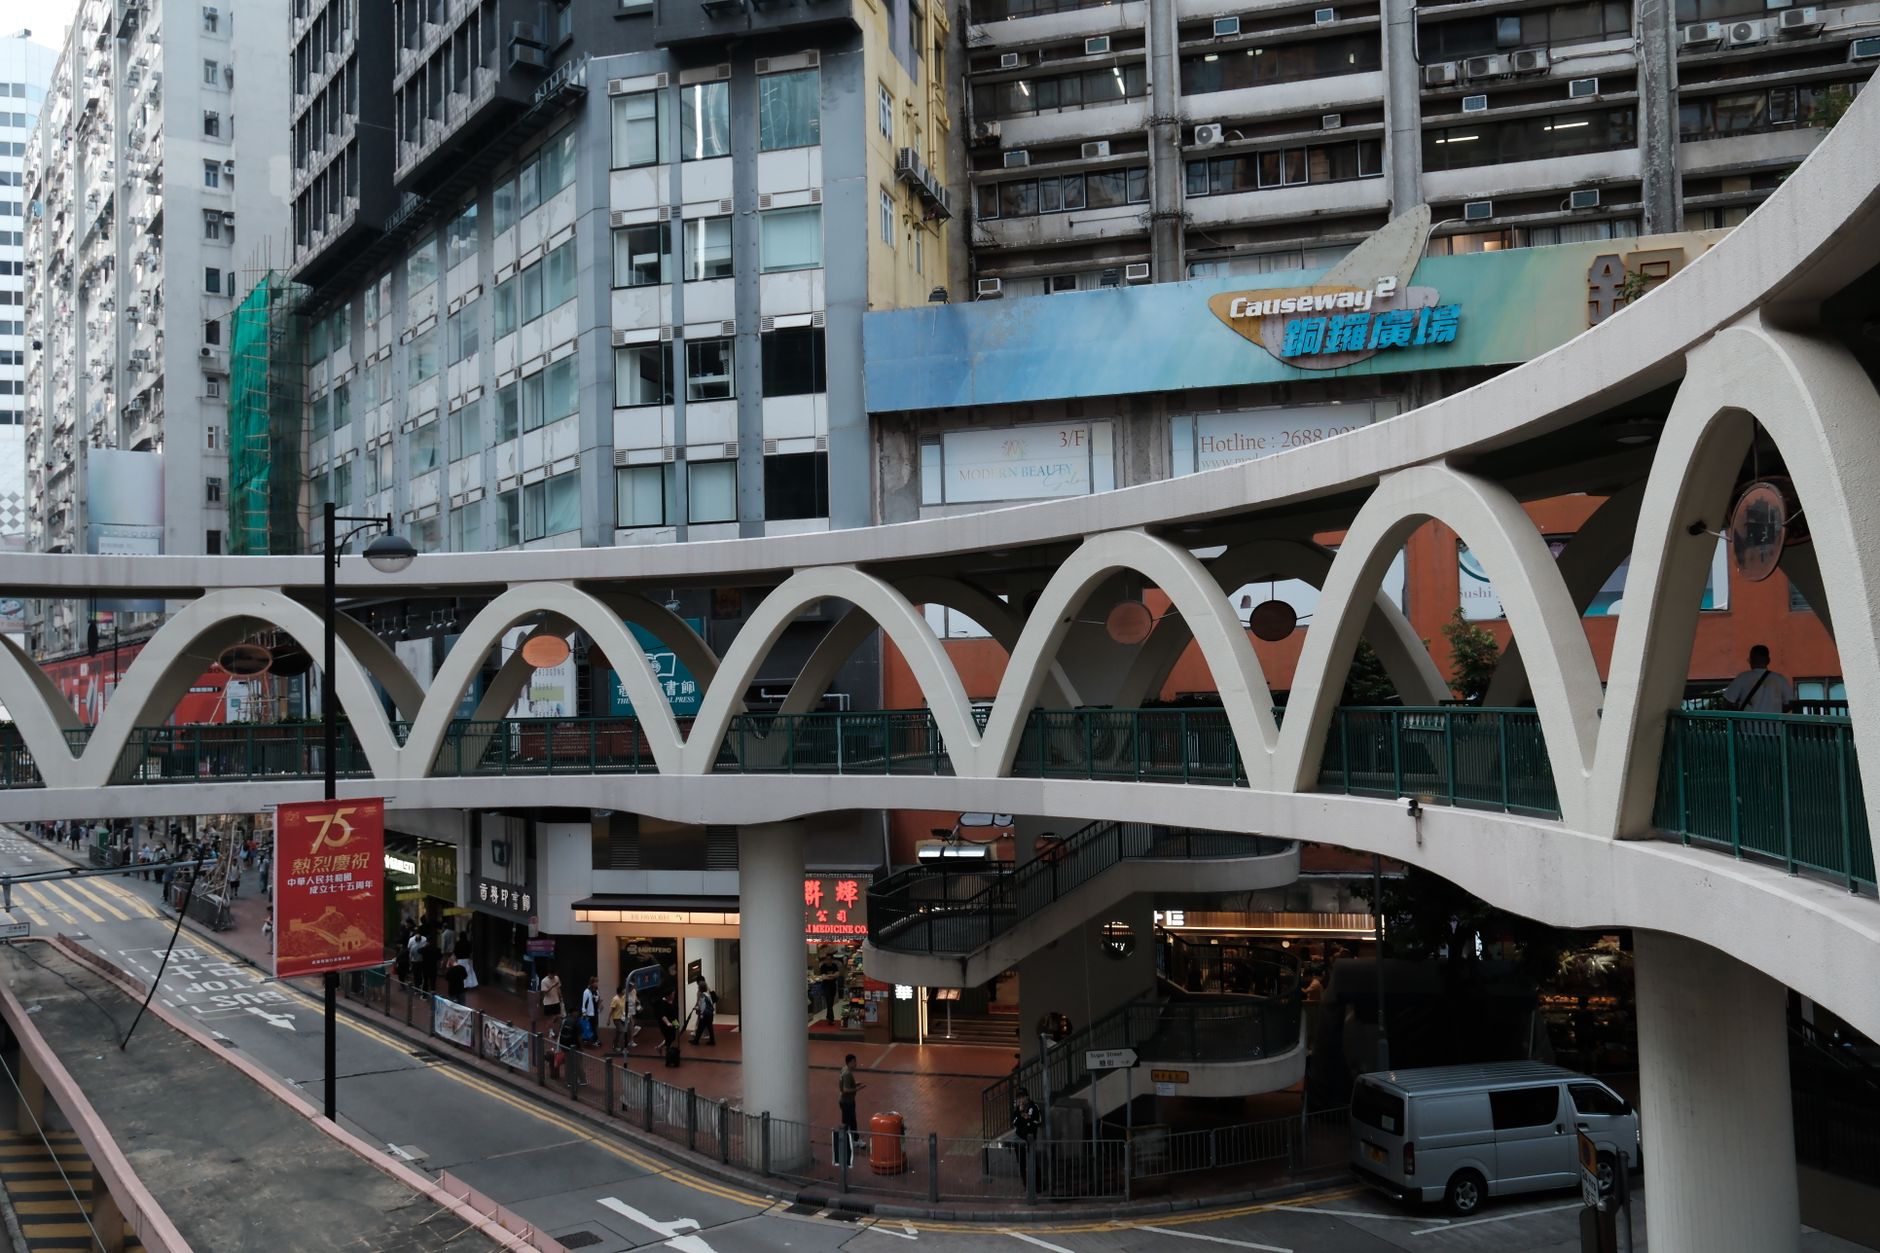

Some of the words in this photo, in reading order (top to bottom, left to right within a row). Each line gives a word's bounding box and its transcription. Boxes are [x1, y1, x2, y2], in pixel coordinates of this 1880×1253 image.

[1280, 303, 1462, 357] 銅鑼廣場
[1058, 429, 1085, 448] 3/F
[1201, 433, 1266, 453] Hotline
[960, 468, 1019, 481] MODERN
[1021, 463, 1072, 477] BEAUTY
[305, 807, 357, 854] 75
[292, 852, 370, 875] 熱烈慶祝
[287, 872, 353, 887] 中華人民共和國
[812, 924, 854, 933] MEDICINE
[854, 925, 869, 934] CO.
[209, 991, 288, 1007] BUS
